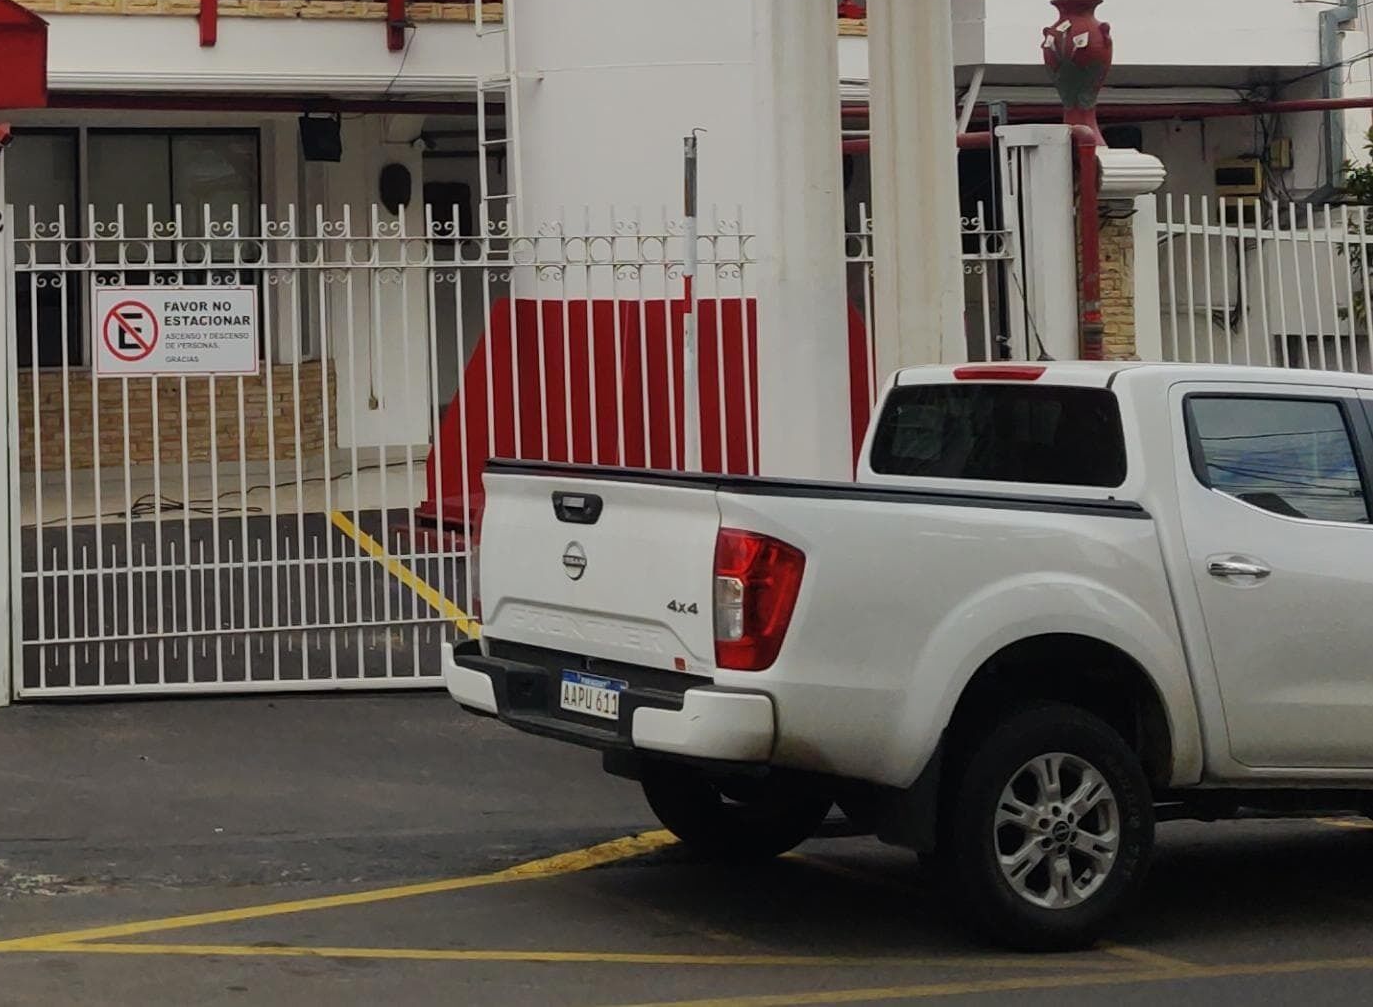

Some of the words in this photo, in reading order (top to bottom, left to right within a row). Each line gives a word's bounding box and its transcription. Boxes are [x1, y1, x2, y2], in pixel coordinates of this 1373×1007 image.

[164, 301, 208, 312] FAVOR
[212, 301, 232, 311] NO
[164, 315, 251, 326] ESTACIONAR
[165, 355, 199, 363] GRACIAS
[666, 599, 699, 615] 4x4
[510, 606, 663, 654] FRONTIER
[563, 683, 592, 710] AAPU
[596, 691, 618, 715] 611
